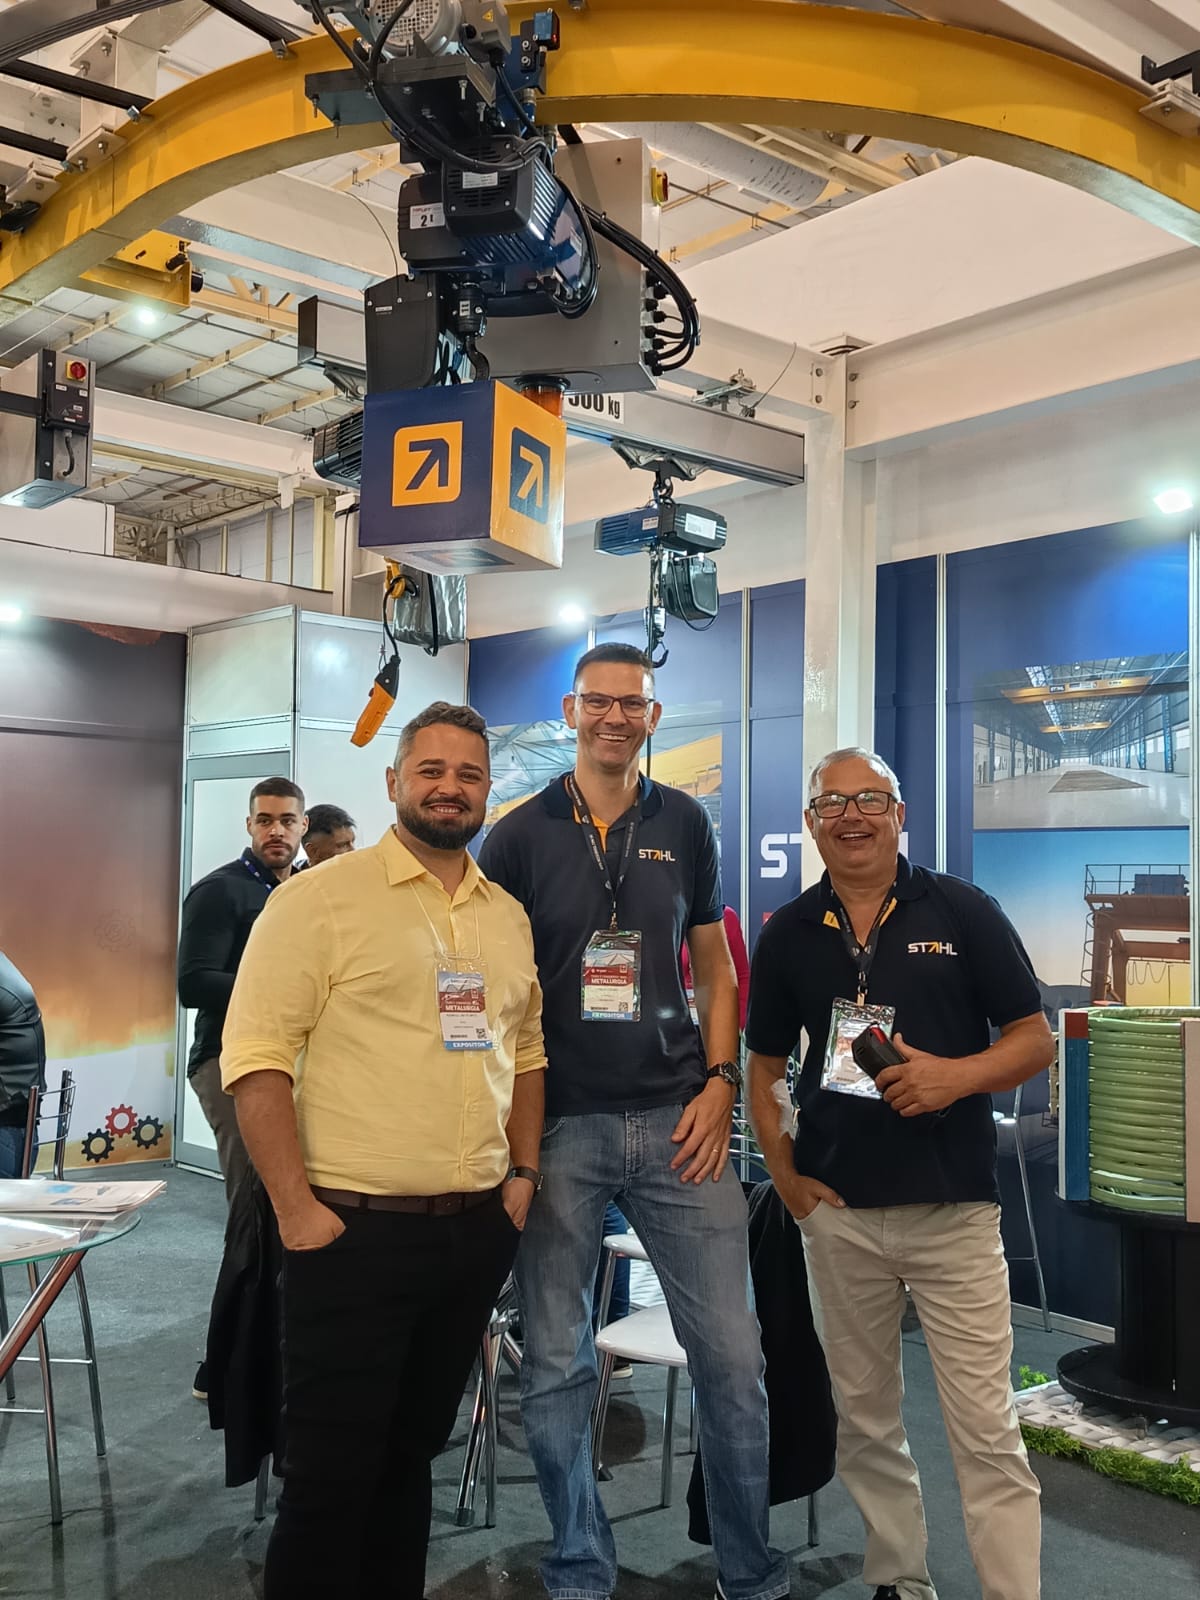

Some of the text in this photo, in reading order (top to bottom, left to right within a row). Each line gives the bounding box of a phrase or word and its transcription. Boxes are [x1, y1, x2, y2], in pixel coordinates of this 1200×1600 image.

[420, 214, 428, 227] 2
[608, 395, 620, 419] kg
[638, 848, 676, 861] STAHL
[907, 941, 958, 956] STAHL
